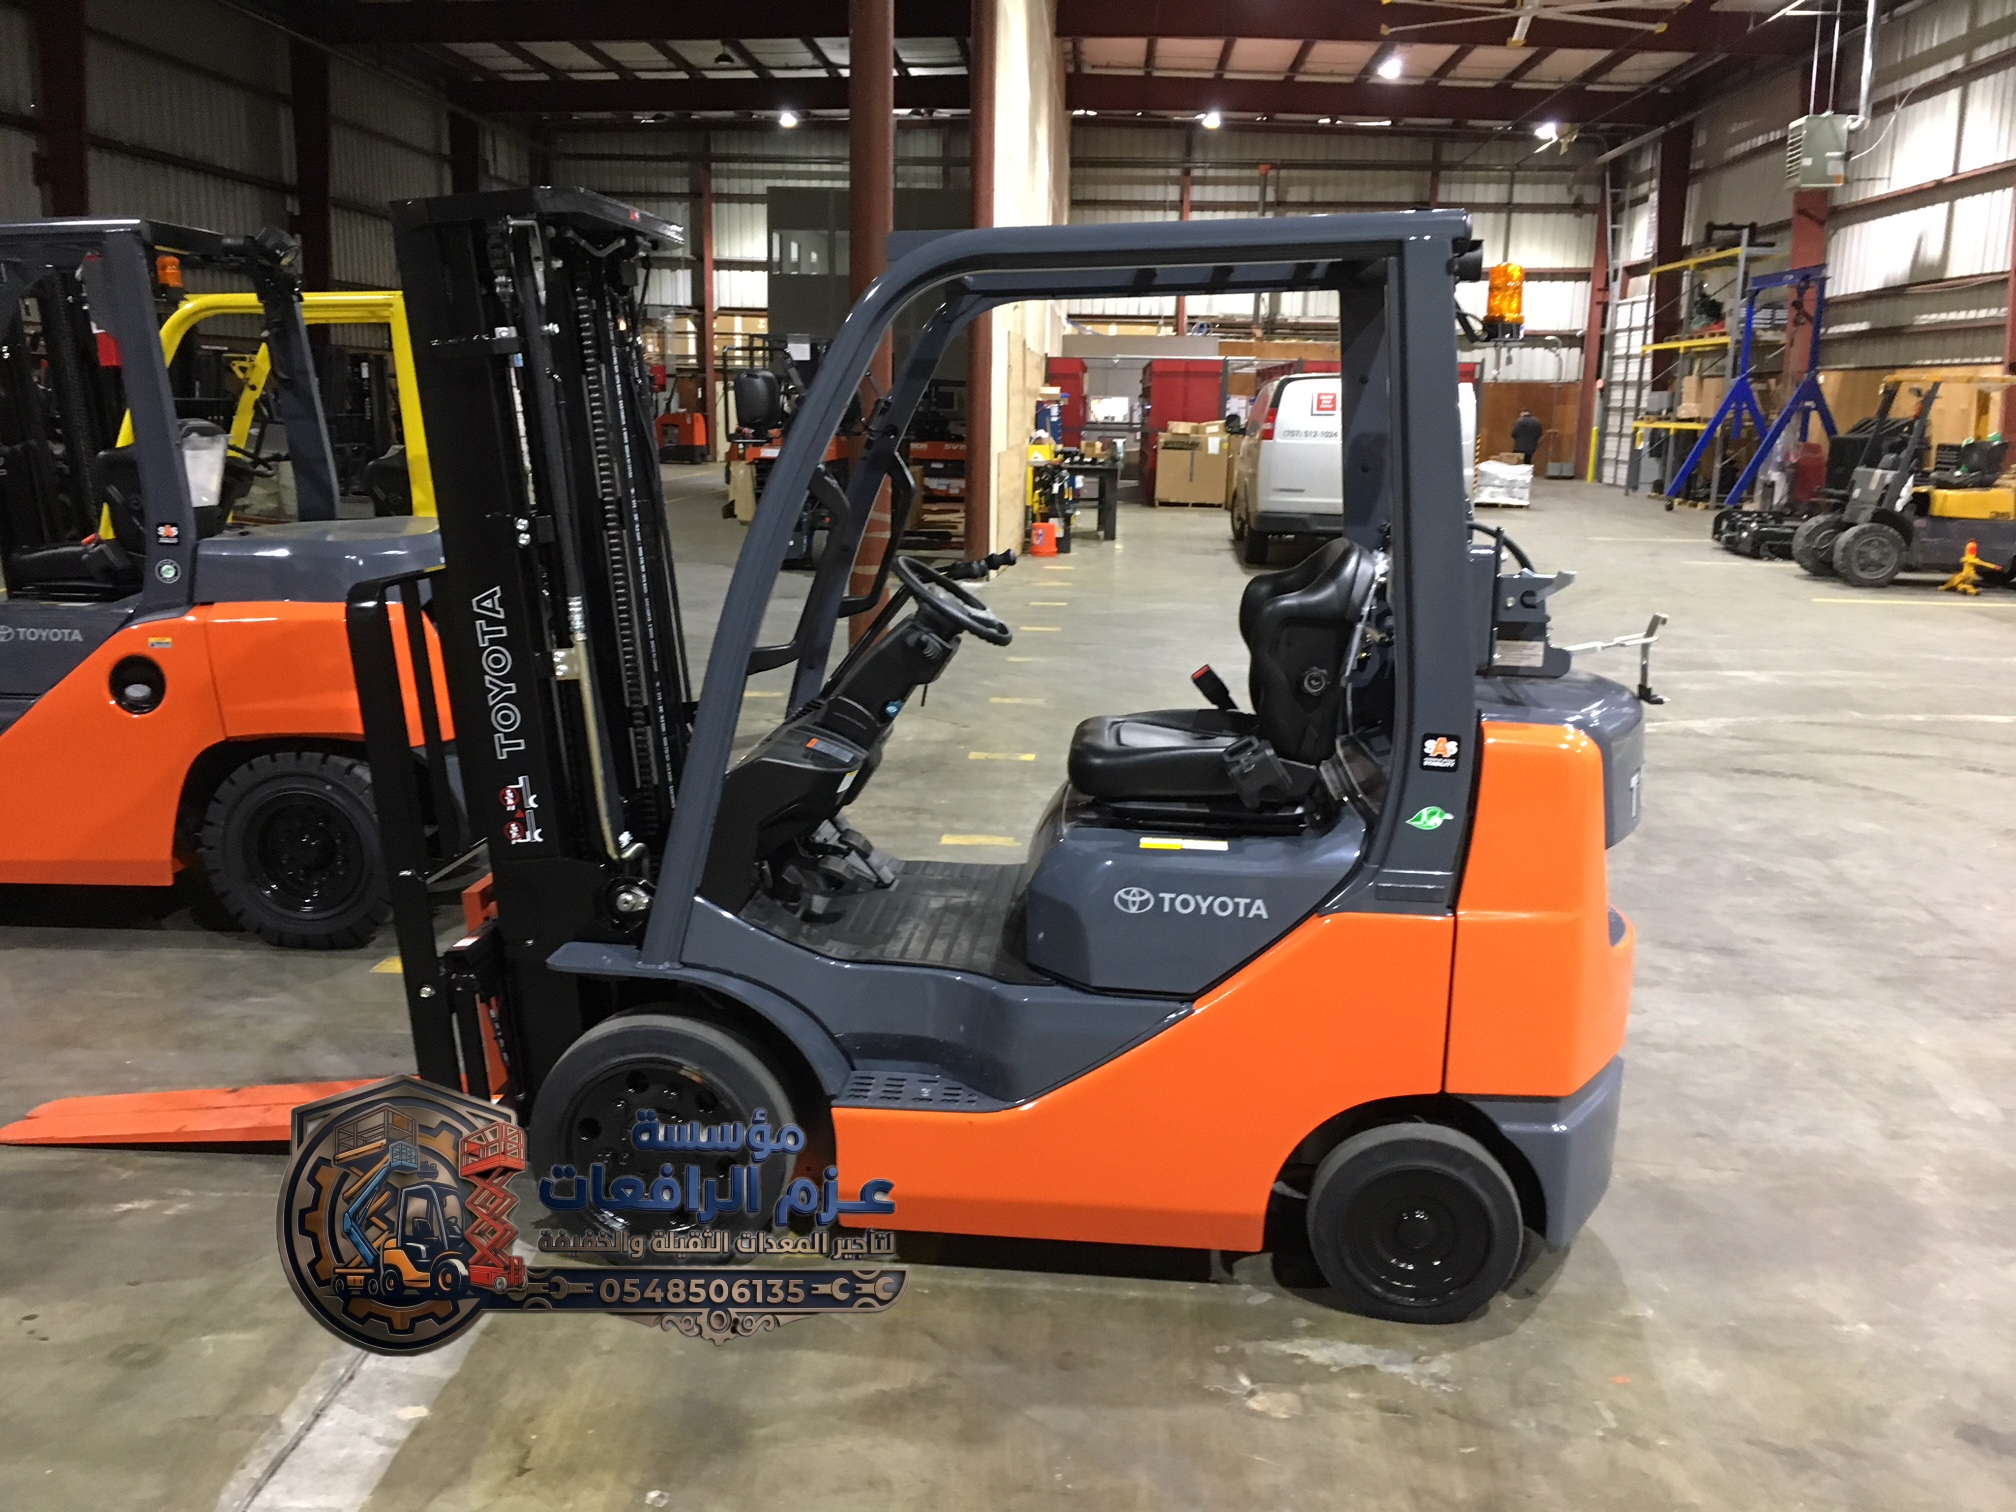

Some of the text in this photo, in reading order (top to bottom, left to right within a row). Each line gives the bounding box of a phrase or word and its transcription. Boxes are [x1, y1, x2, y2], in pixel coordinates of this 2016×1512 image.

[16, 628, 84, 642] TOYOTA
[471, 585, 526, 760] TOYOTA
[1423, 736, 1459, 758] SAS
[1158, 893, 1269, 919] TOYOTA
